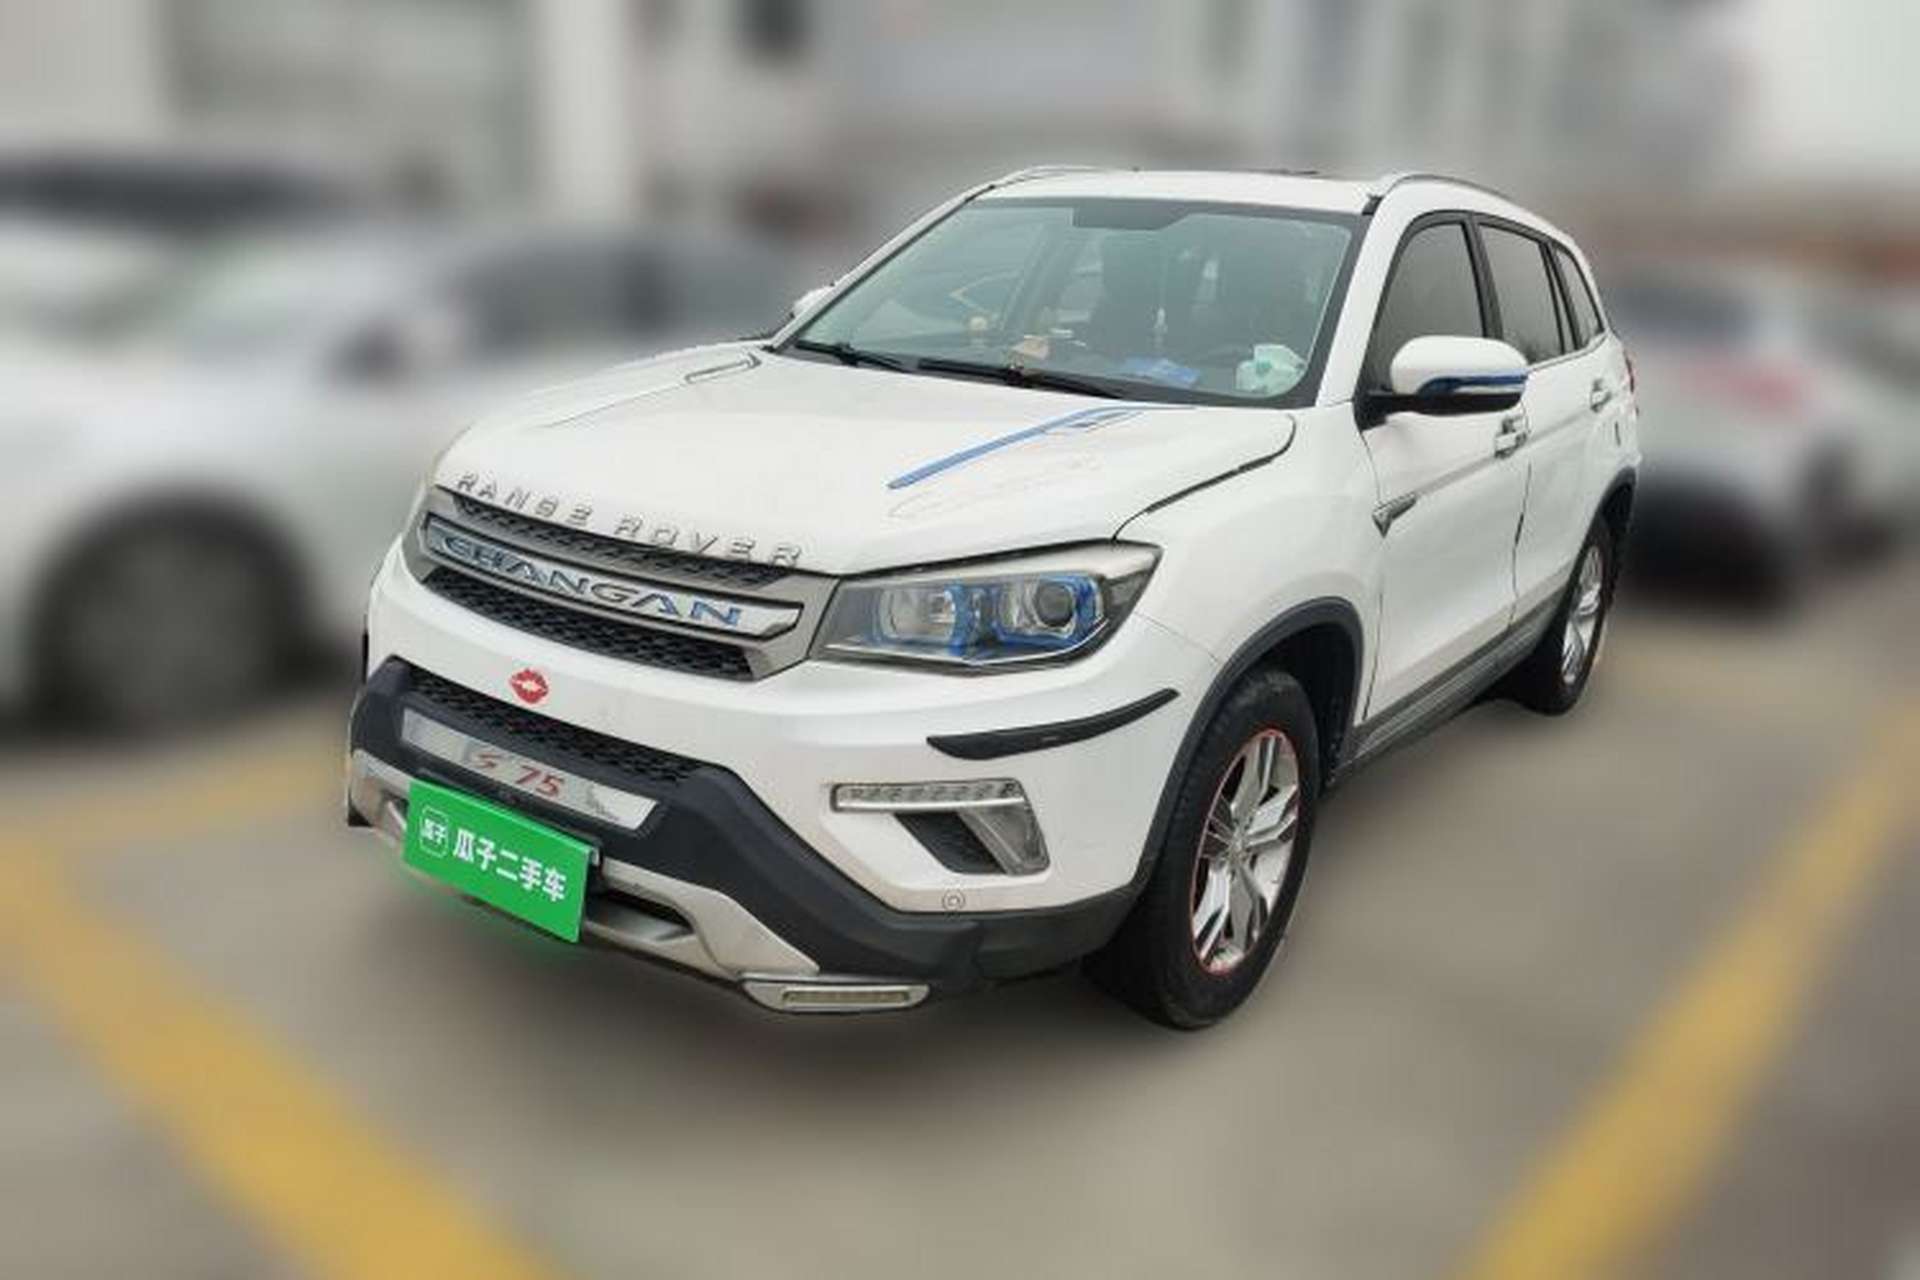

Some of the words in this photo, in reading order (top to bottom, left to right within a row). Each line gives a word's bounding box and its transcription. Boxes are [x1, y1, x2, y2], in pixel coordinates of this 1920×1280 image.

[456, 471, 594, 527] RANGE
[613, 512, 802, 569] ROVER
[441, 534, 742, 628] CHANGAN
[514, 764, 565, 797] 75
